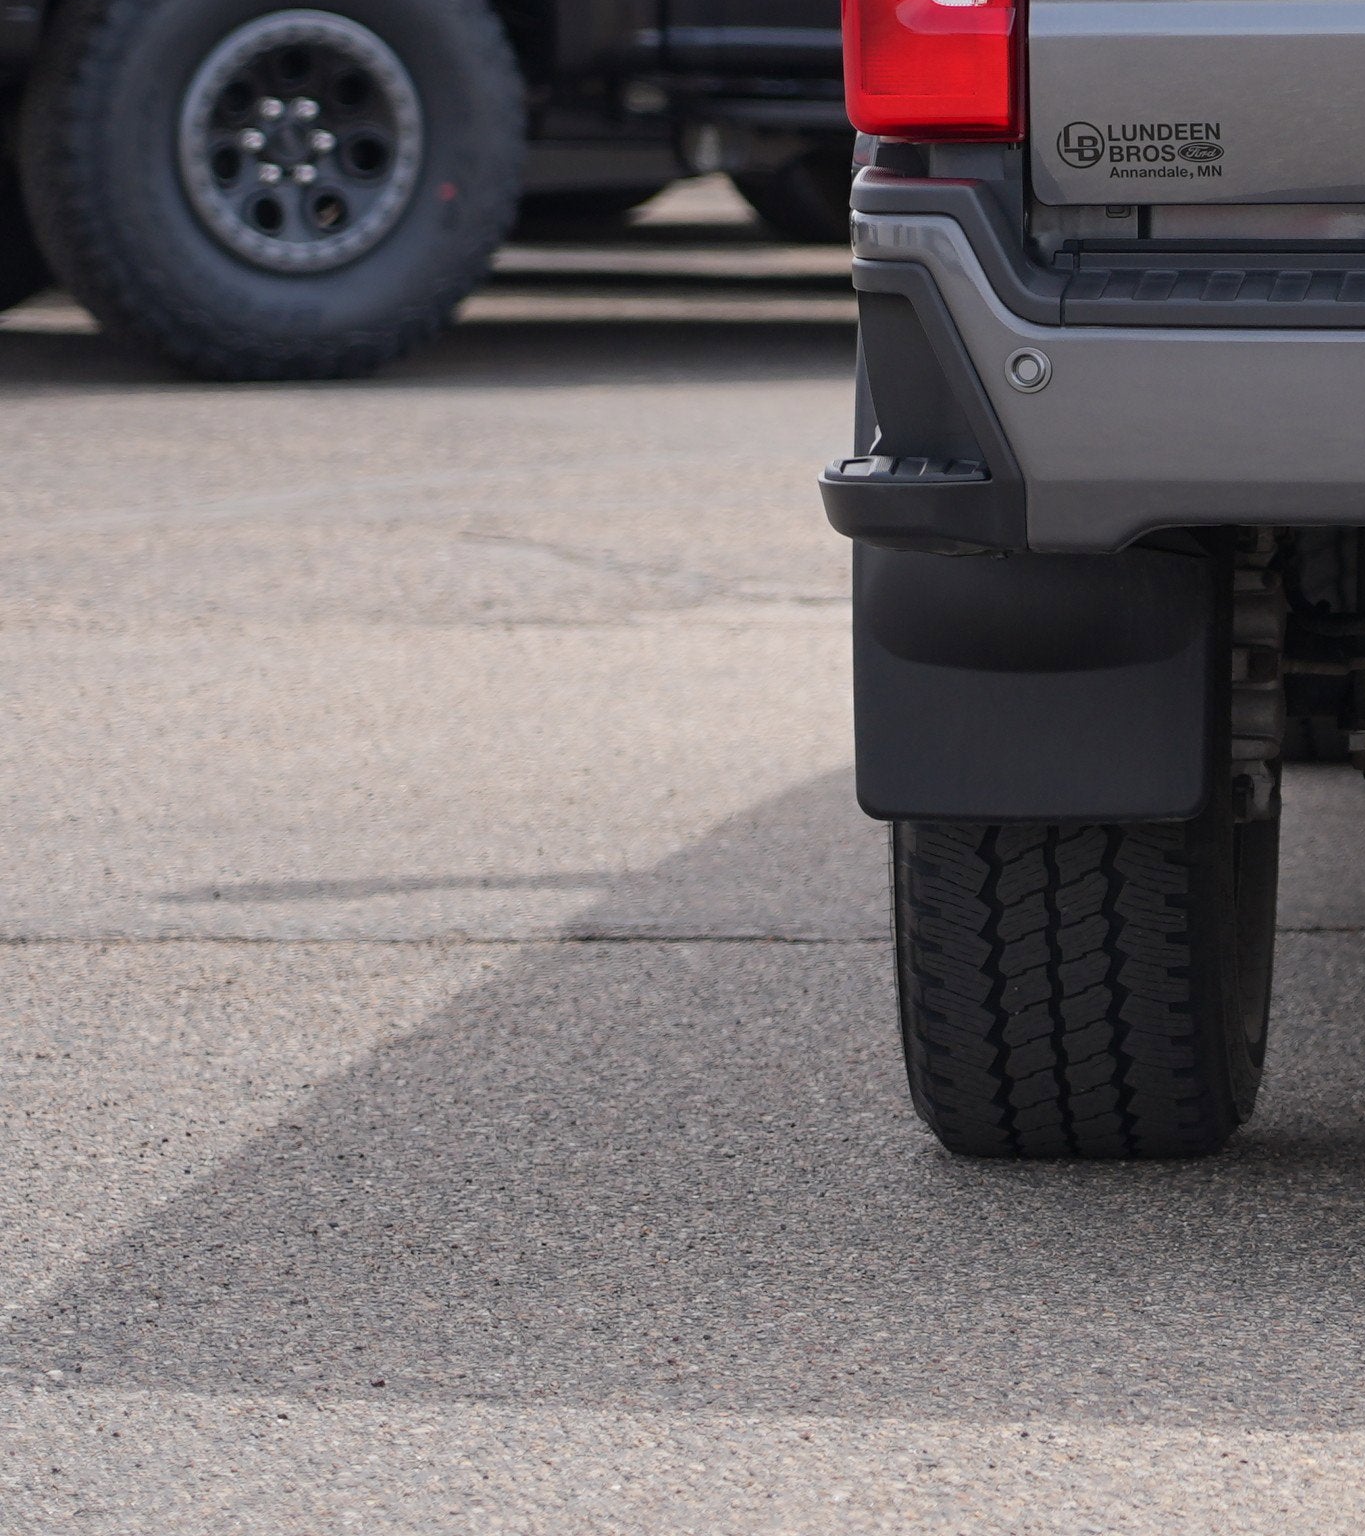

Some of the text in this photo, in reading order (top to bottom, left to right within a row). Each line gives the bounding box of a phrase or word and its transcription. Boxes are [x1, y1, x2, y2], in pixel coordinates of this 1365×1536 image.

[1107, 122, 1221, 142] LUNDEEN
[1109, 144, 1176, 163] BROS
[1109, 165, 1222, 180] Annandale, MN
